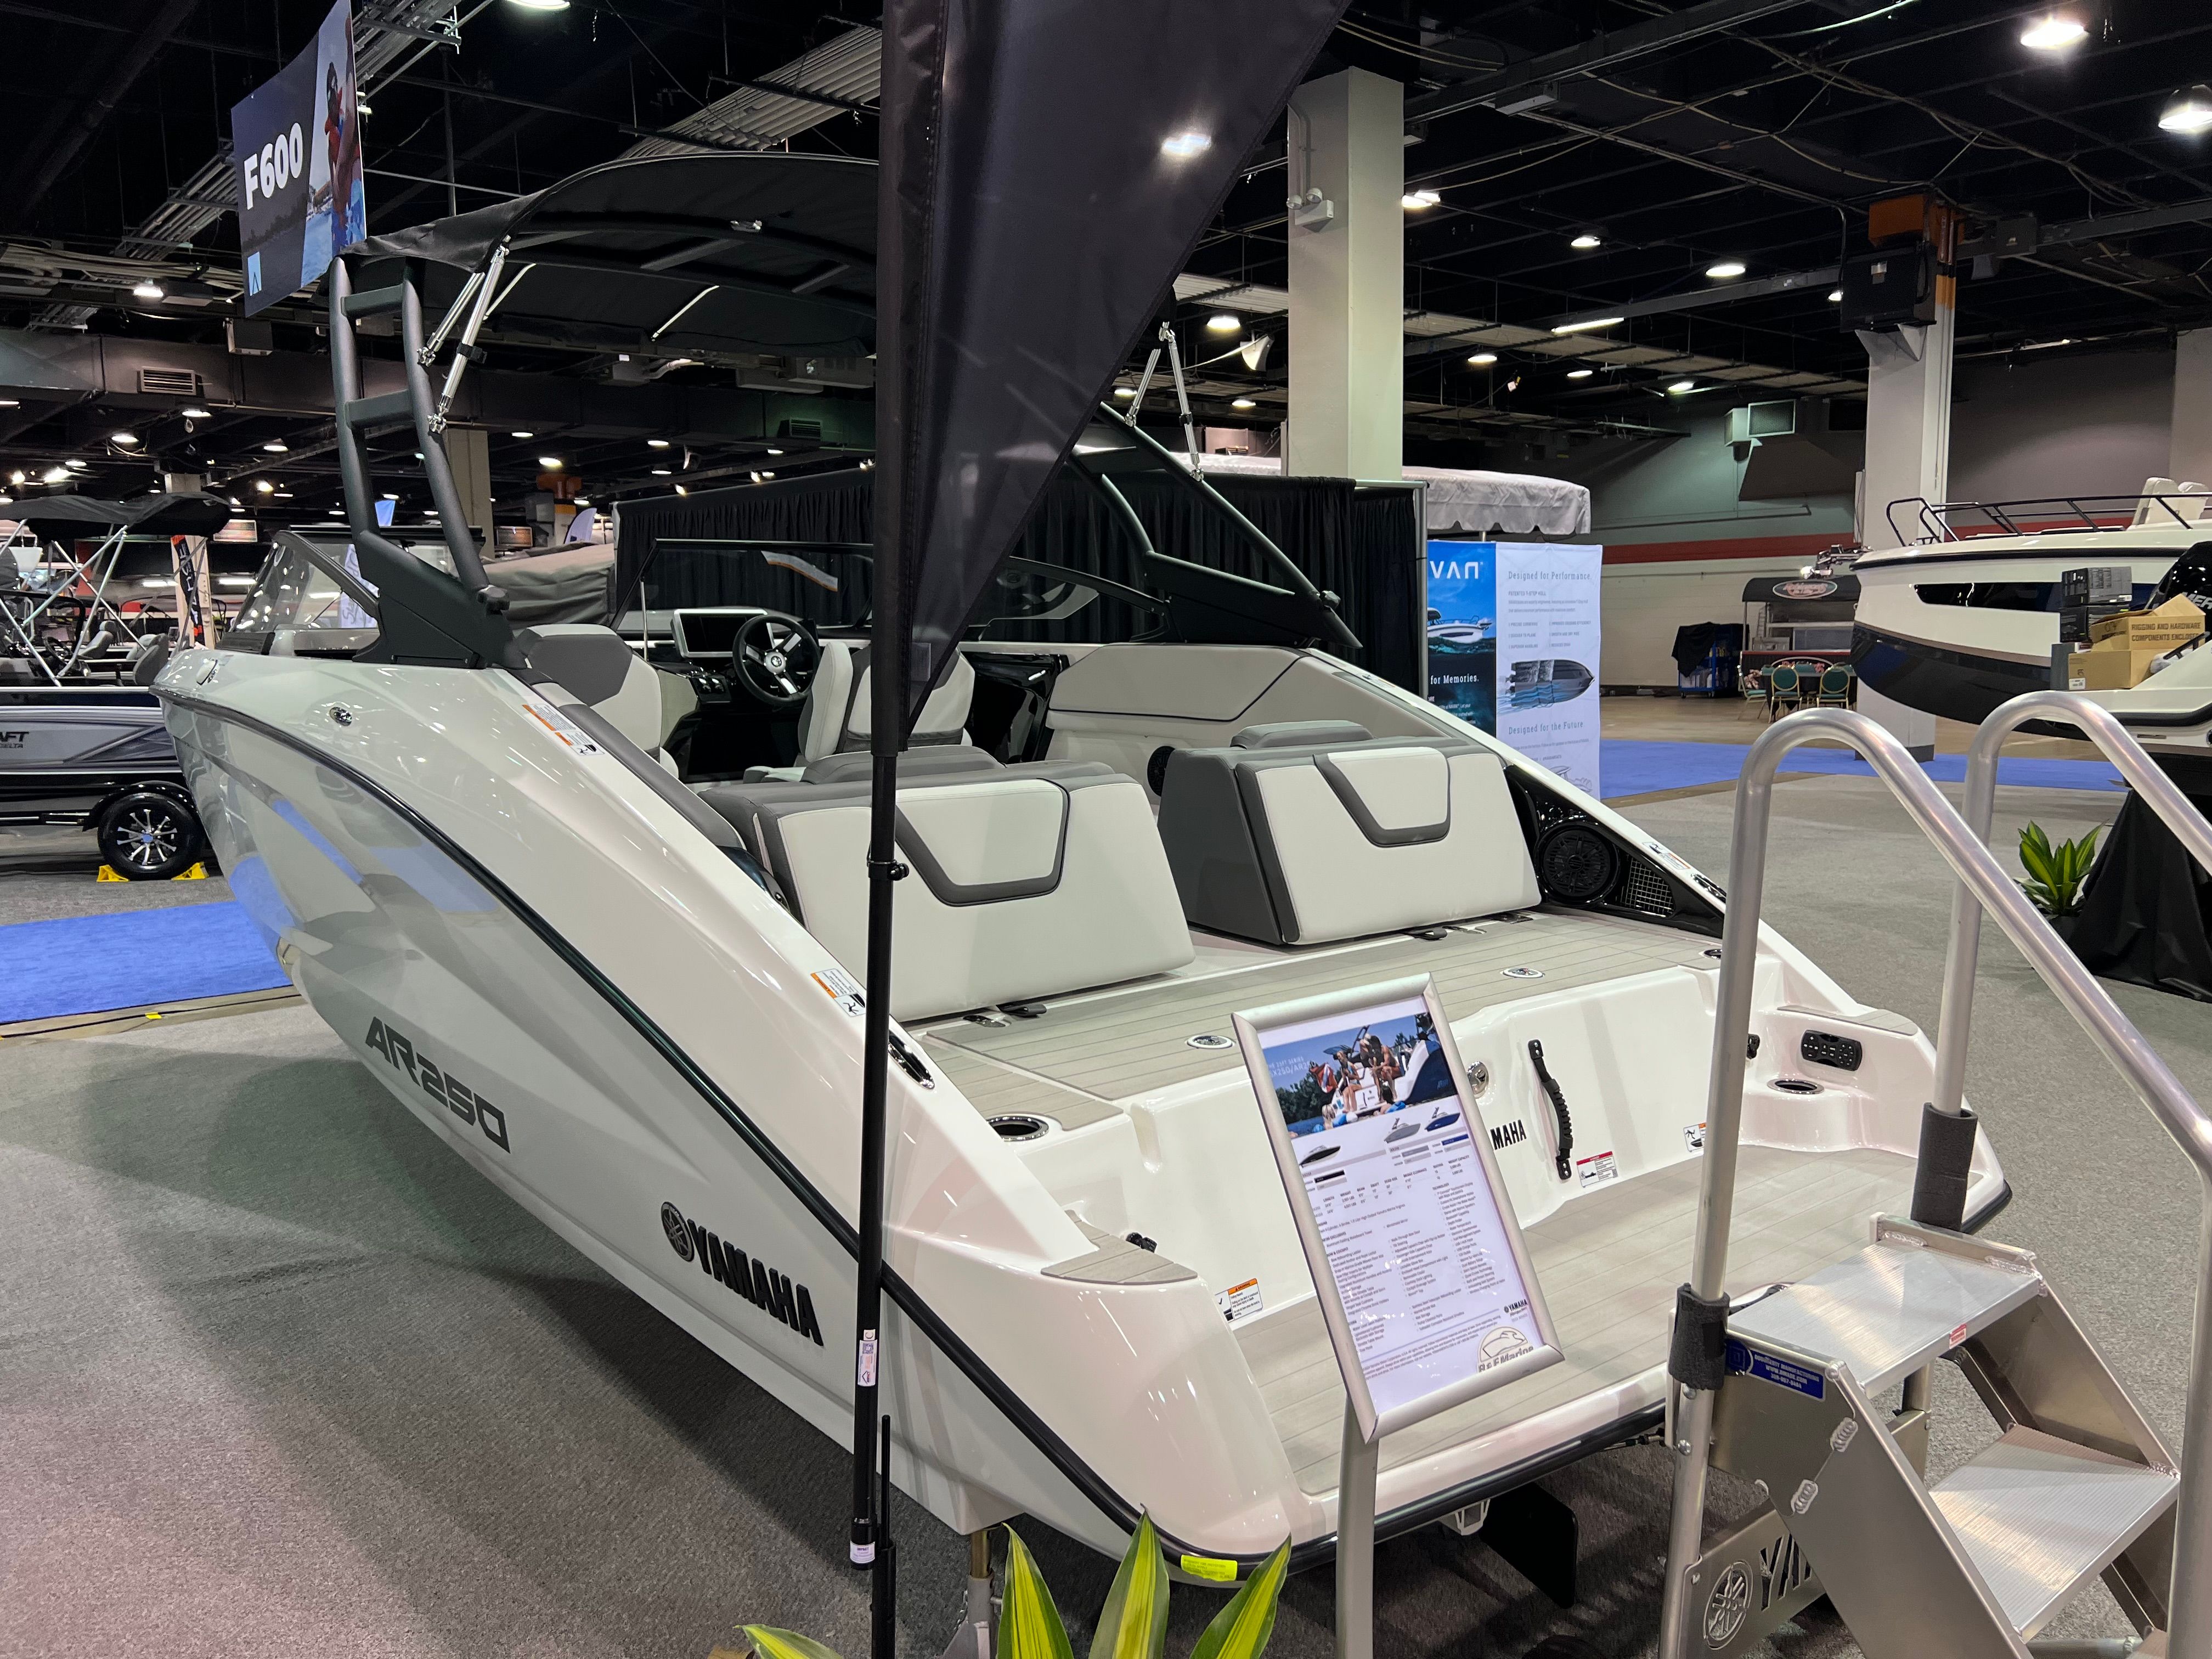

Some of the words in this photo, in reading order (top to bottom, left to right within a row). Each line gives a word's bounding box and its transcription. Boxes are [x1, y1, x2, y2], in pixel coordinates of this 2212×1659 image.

[244, 122, 304, 211] F600
[1509, 571, 1538, 580] Designed
[1540, 571, 1549, 579] for
[1430, 675, 1441, 685] for
[1443, 673, 1479, 684] Memories.
[1509, 724, 1538, 735] Designed
[1540, 724, 1549, 732] for
[1564, 721, 1583, 730] Future
[365, 1017, 511, 1154] AR250
[1490, 1119, 1527, 1150] MAHA
[687, 1218, 824, 1347] YAMAHA
[1508, 1299, 1528, 1311] YAMAHA
[1500, 1345, 1534, 1364] Marine
